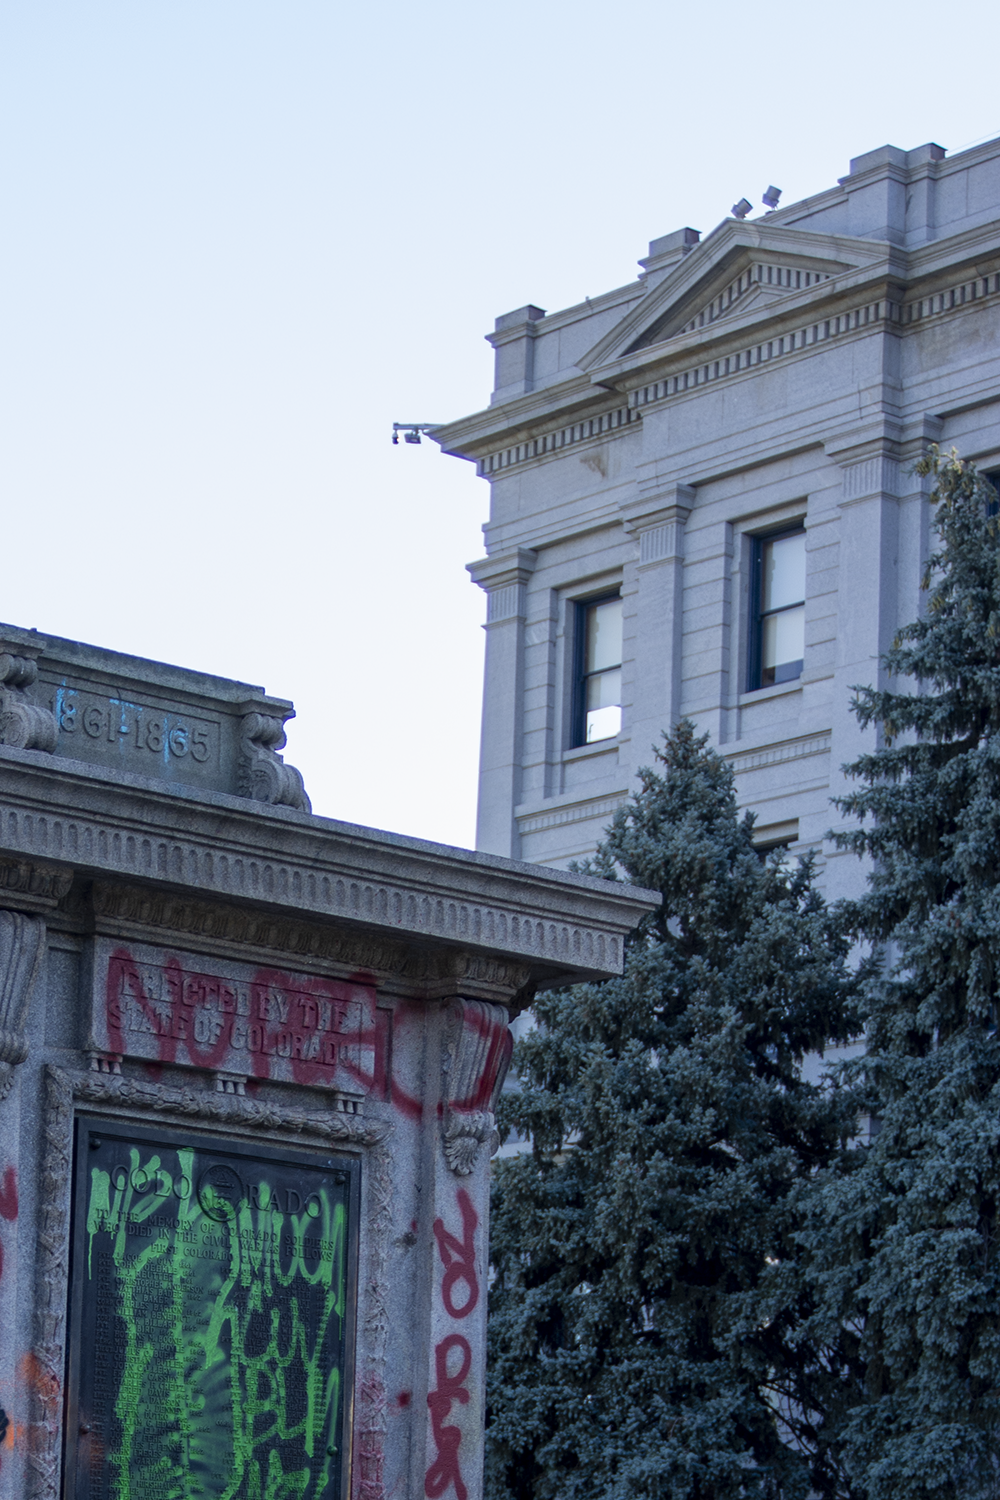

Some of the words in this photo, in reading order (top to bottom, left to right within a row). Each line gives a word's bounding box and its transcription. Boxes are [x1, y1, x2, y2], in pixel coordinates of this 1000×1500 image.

[120, 964, 248, 1017] ERECTED
[256, 990, 289, 1024] BY
[299, 997, 351, 1034] THE
[109, 1002, 188, 1041] STATE
[194, 1014, 226, 1046] OF
[229, 1018, 350, 1067] COLORADO
[117, 1211, 140, 1225] THE
[148, 1215, 194, 1232] MEMORY
[200, 1222, 214, 1235] OF
[220, 1225, 278, 1244] COLORADO
[284, 1233, 334, 1251] SOLDIERS
[128, 1224, 153, 1238] DIED
[157, 1228, 172, 1241] IN
[176, 1230, 198, 1244] THE
[201, 1233, 231, 1249] CIVIL
[265, 1242, 280, 1255] AS
[150, 1242, 177, 1255] FIRST
[182, 1246, 233, 1263] COLORADO
